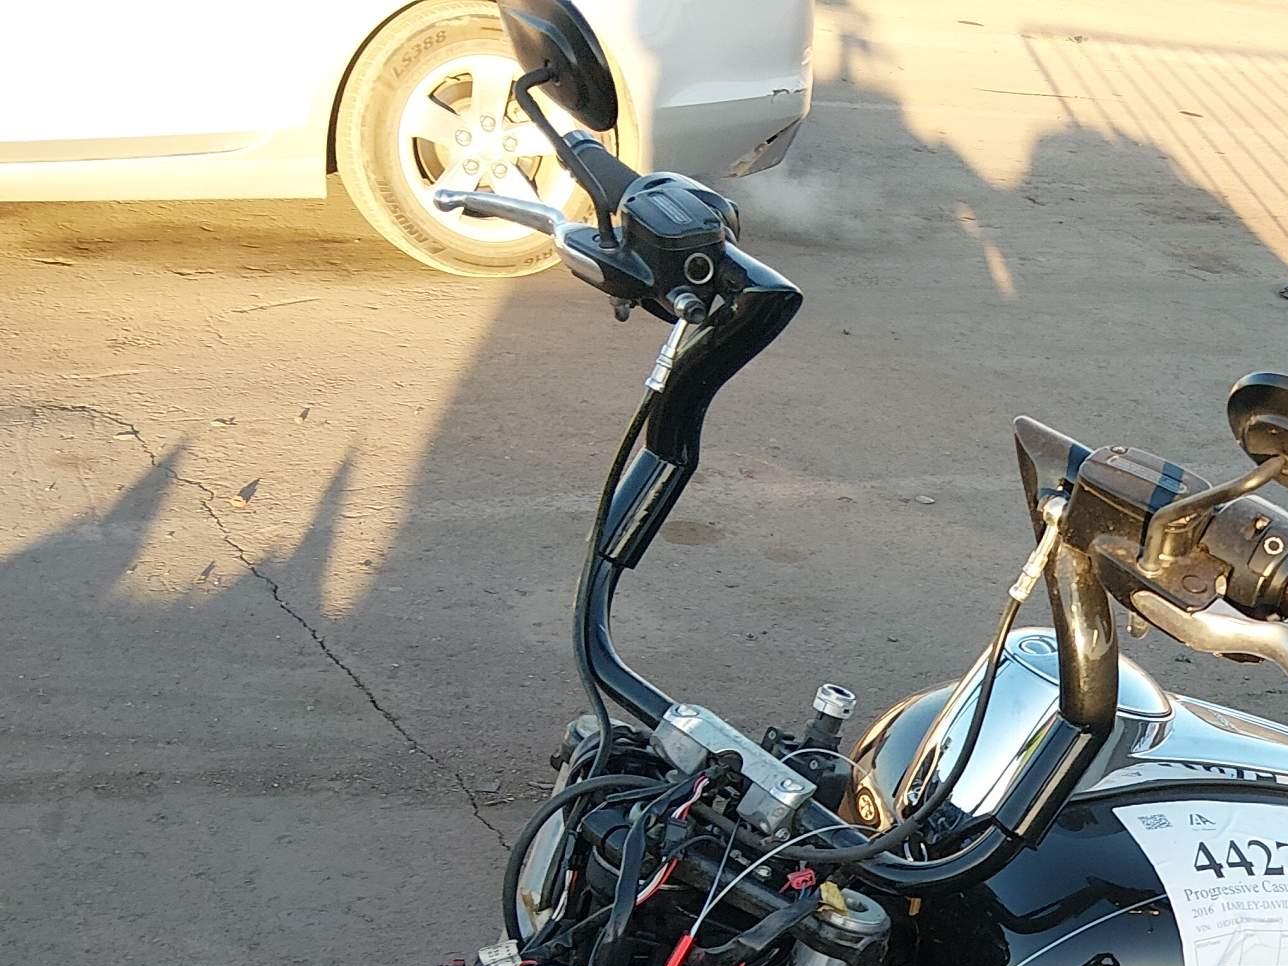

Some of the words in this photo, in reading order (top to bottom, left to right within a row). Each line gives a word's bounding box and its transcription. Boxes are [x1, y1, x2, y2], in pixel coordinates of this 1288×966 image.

[390, 29, 448, 79] LS388
[1184, 883, 1259, 902] Progressive
[1191, 906, 1215, 920] 2016
